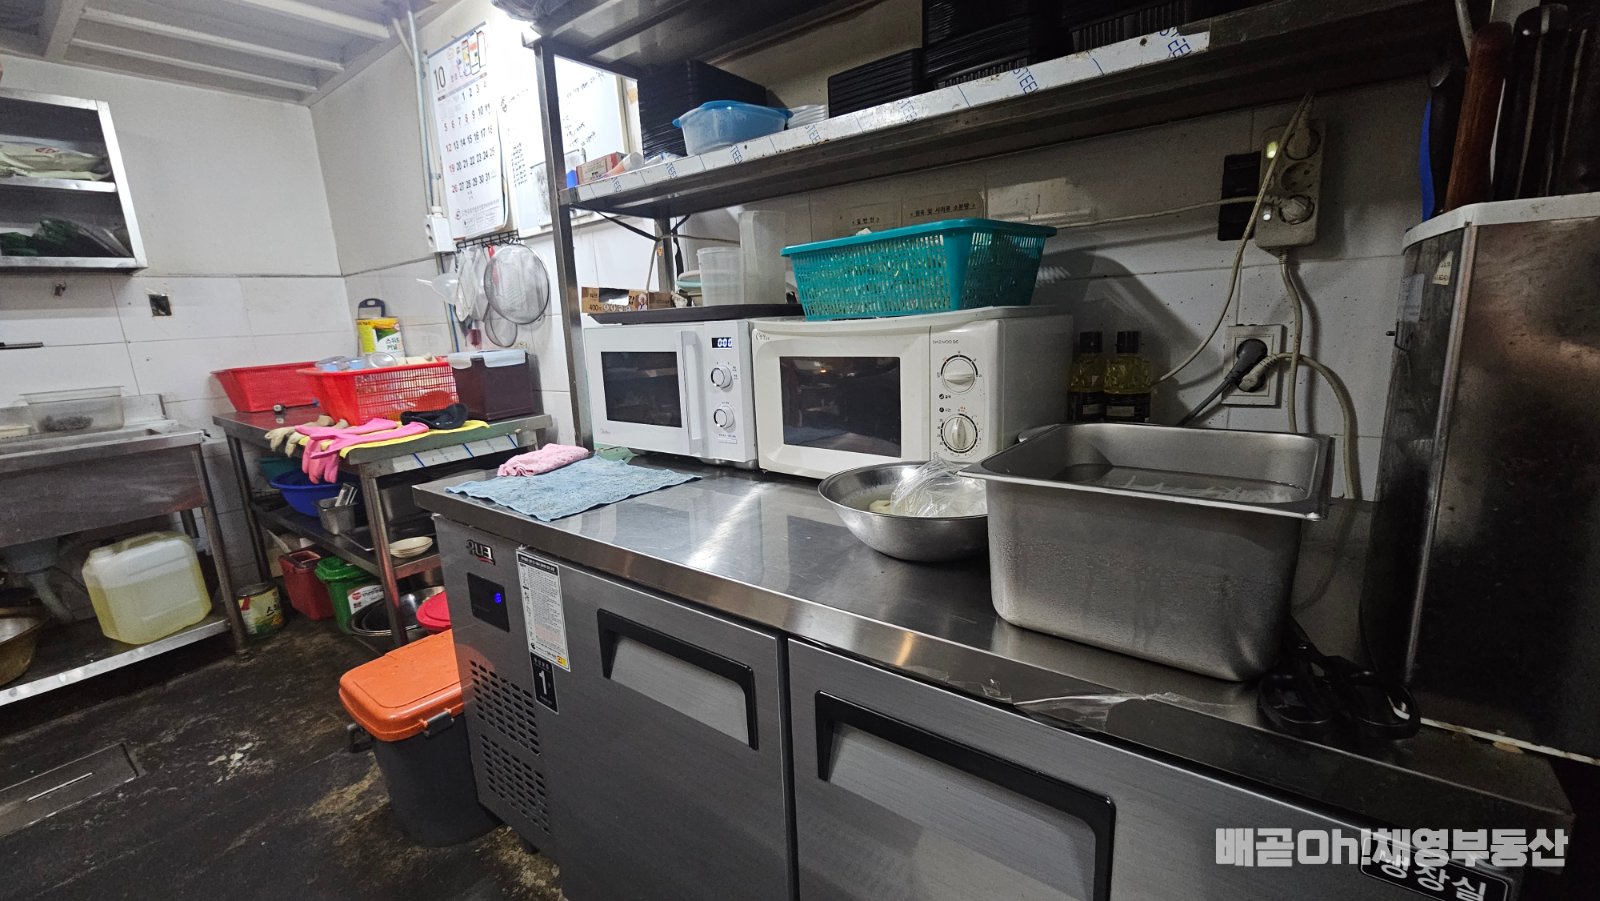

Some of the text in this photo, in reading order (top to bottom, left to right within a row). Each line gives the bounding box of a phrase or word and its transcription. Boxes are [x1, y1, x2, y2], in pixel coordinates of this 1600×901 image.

[1160, 27, 1193, 58] STEE
[434, 66, 446, 90] 10
[451, 120, 455, 129] 6
[458, 116, 462, 126] 7
[465, 113, 469, 123] 8
[472, 110, 476, 119] 9
[478, 105, 483, 116] 10
[446, 143, 452, 152] 12
[453, 140, 459, 150] 13
[460, 137, 466, 147] 14
[467, 134, 473, 144] 15
[474, 131, 479, 141] 16
[481, 127, 486, 138] 17
[449, 163, 455, 173] 19
[456, 160, 462, 171] 20
[463, 158, 469, 168] 21
[470, 155, 475, 166] 22
[477, 152, 482, 163] 23
[483, 150, 489, 160] 24
[729, 145, 743, 165] TEE
[452, 172, 491, 193] 26 27 28 29 30 31
[665, 162, 678, 180] TEE
[538, 670, 548, 695] 1
[1379, 850, 1487, 901] 냉장실
